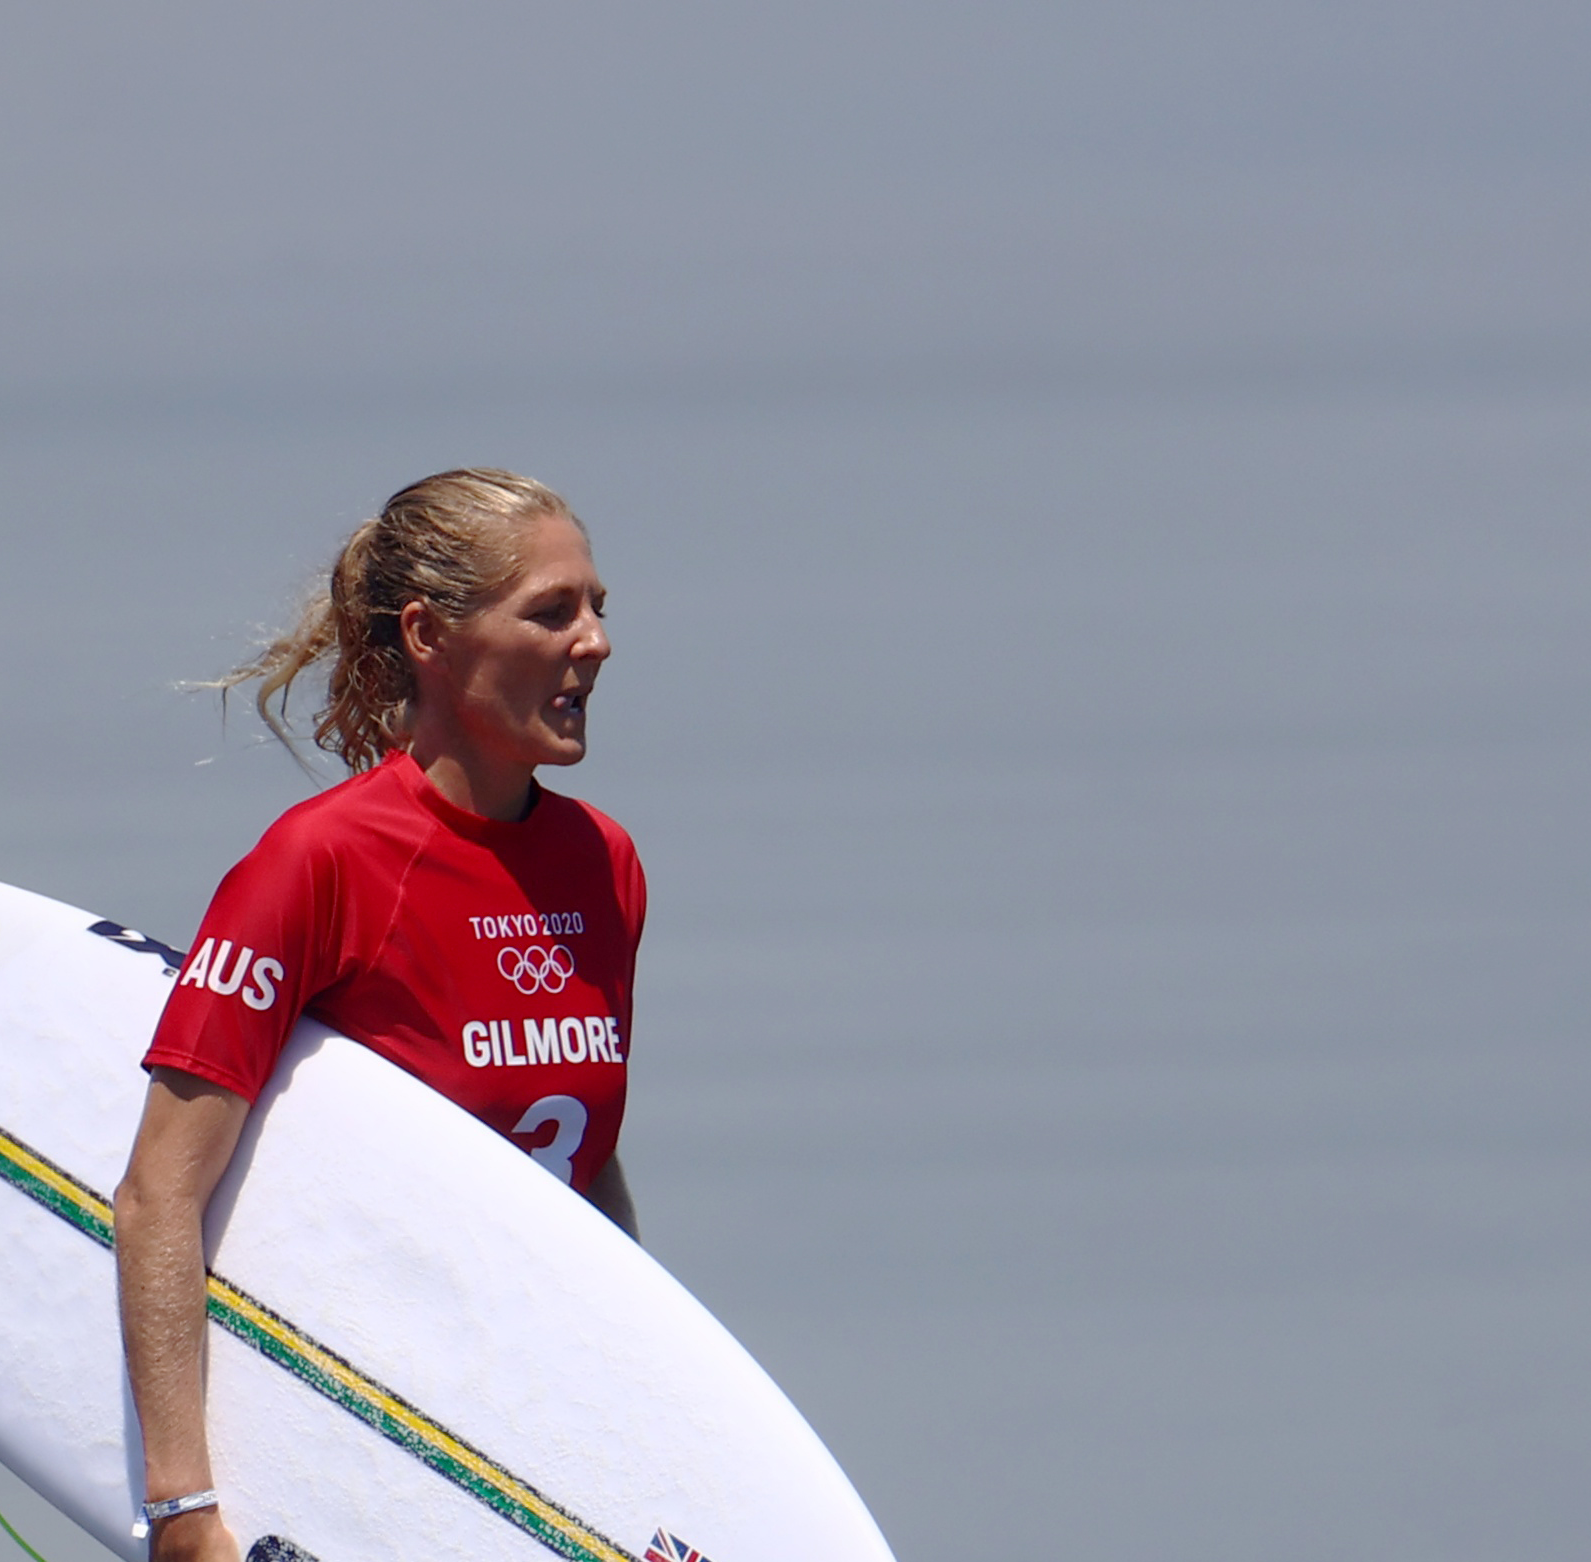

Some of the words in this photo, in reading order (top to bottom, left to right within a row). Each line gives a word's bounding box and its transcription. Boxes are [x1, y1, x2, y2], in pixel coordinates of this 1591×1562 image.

[468, 913, 538, 940] TOKYO
[538, 911, 584, 936] 2020
[179, 937, 285, 1011] AUS
[462, 1016, 624, 1068] GILMORE
